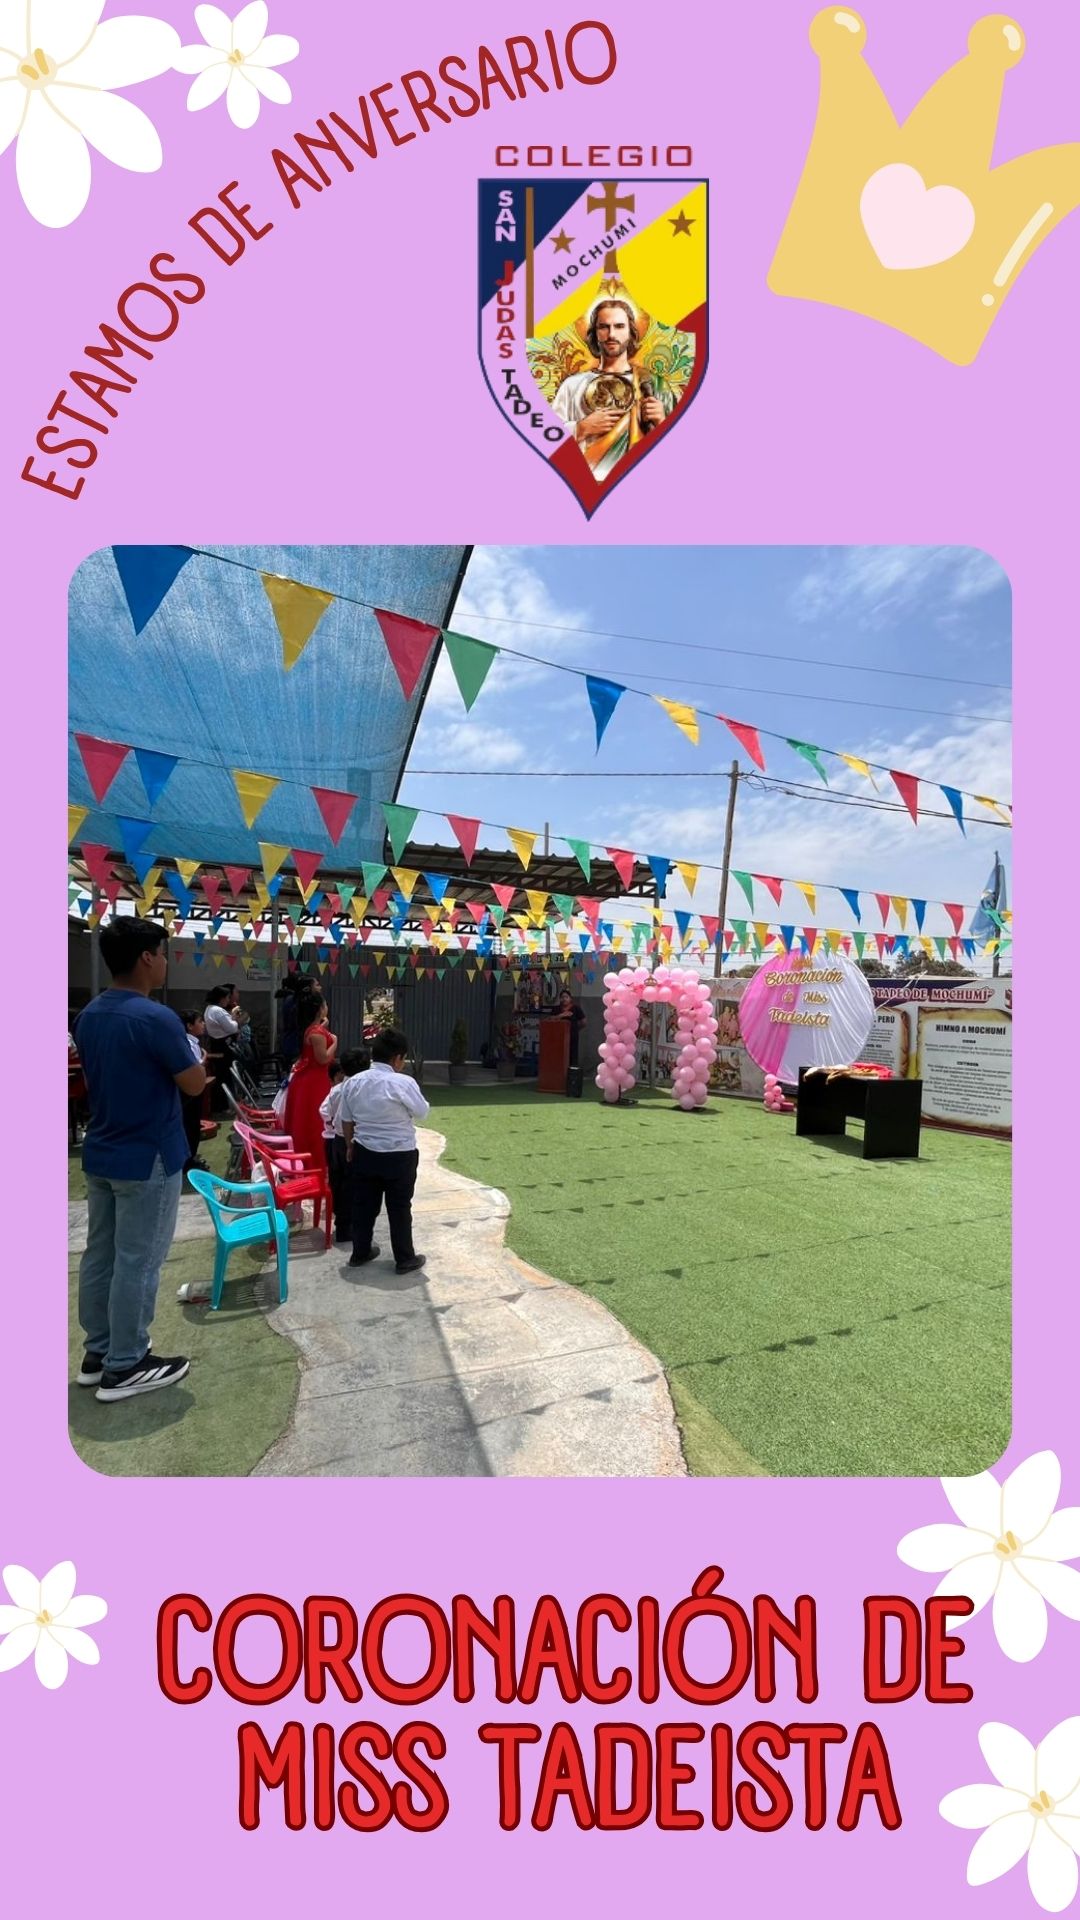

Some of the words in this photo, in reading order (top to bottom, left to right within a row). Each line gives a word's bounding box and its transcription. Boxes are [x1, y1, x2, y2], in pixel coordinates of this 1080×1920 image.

[764, 968, 843, 986] Coronación
[783, 989, 794, 1004] de
[803, 991, 829, 1004] Miss
[768, 1006, 831, 1028] Tadeista
[936, 1024, 960, 1033] HIMNO
[961, 1025, 967, 1033] A
